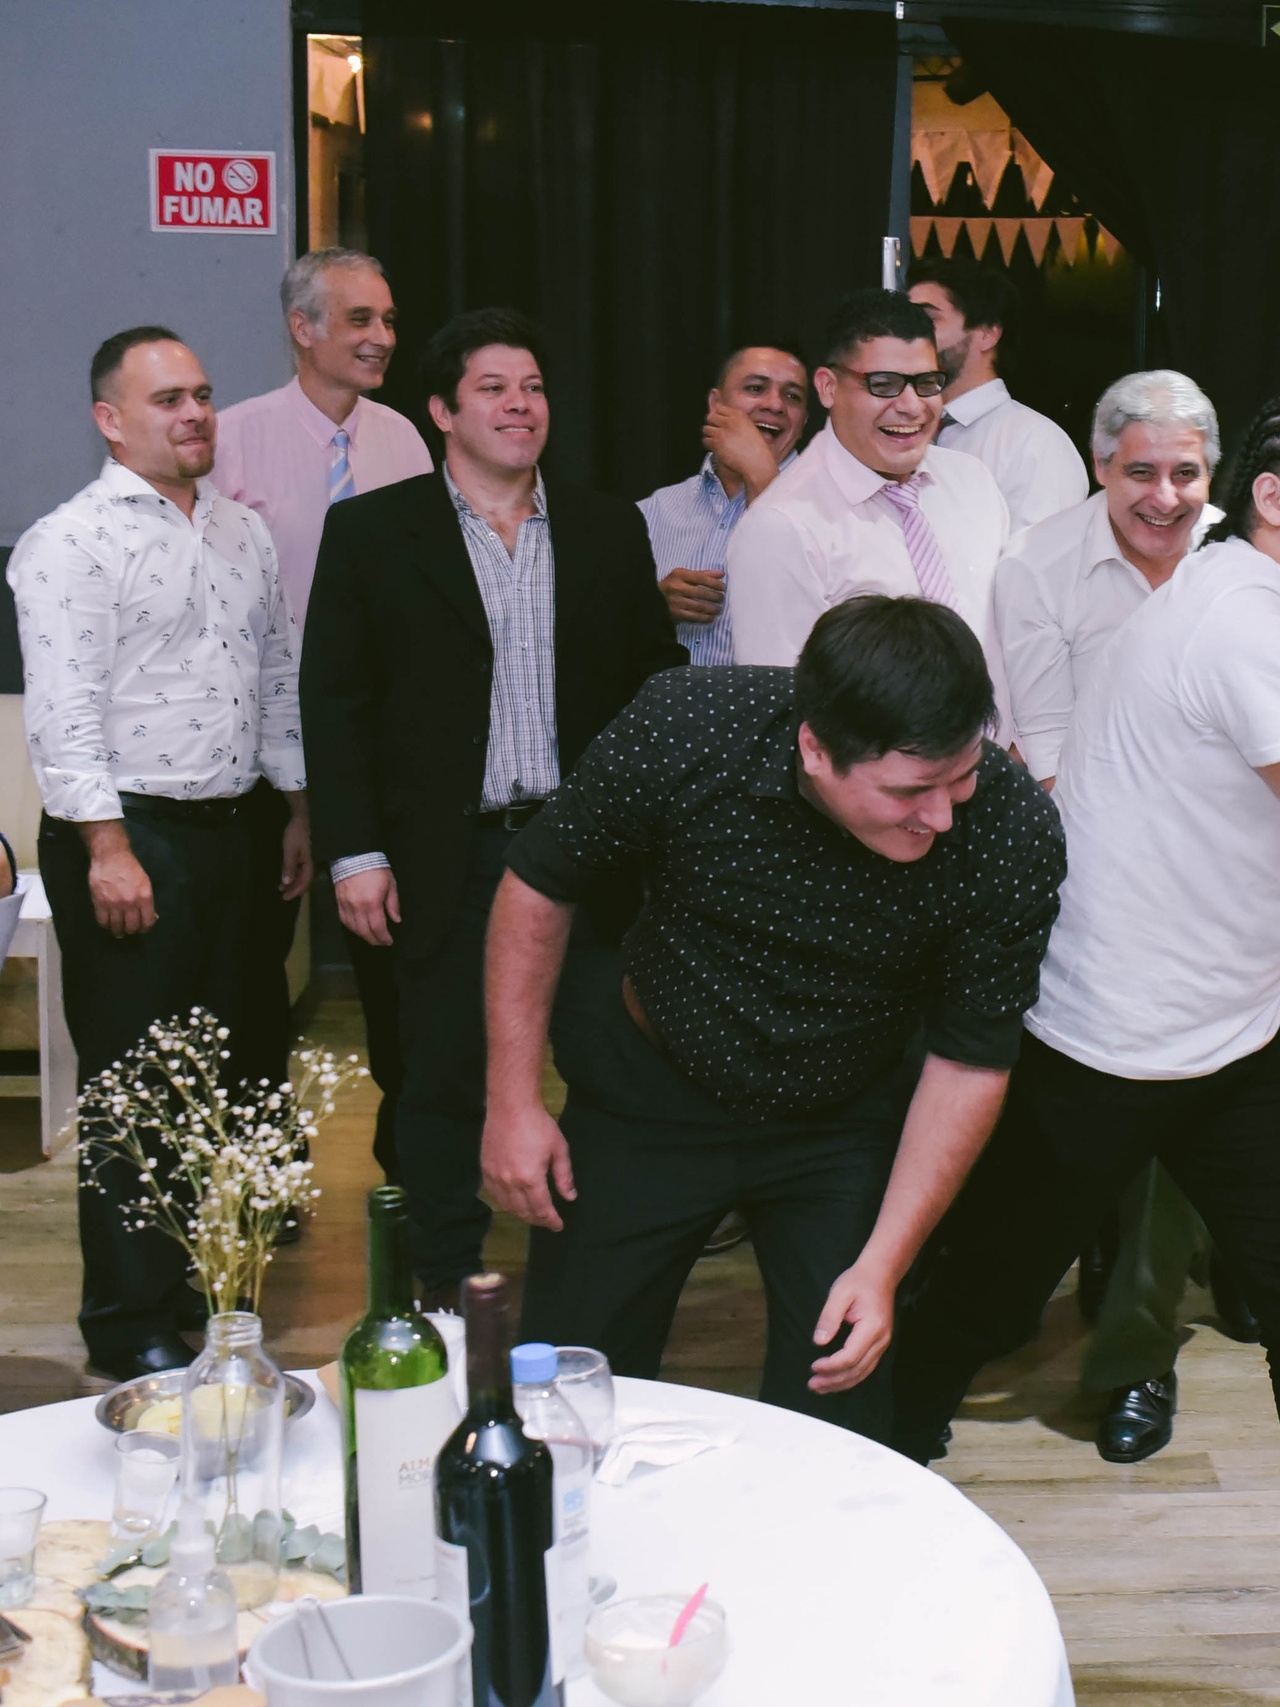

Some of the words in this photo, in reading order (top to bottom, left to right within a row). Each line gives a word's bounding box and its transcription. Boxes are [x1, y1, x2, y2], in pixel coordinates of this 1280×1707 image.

[174, 161, 215, 193] NO
[163, 195, 264, 225] FUMAR
[399, 1456, 436, 1473] ALM
[399, 1469, 432, 1485] MOR
